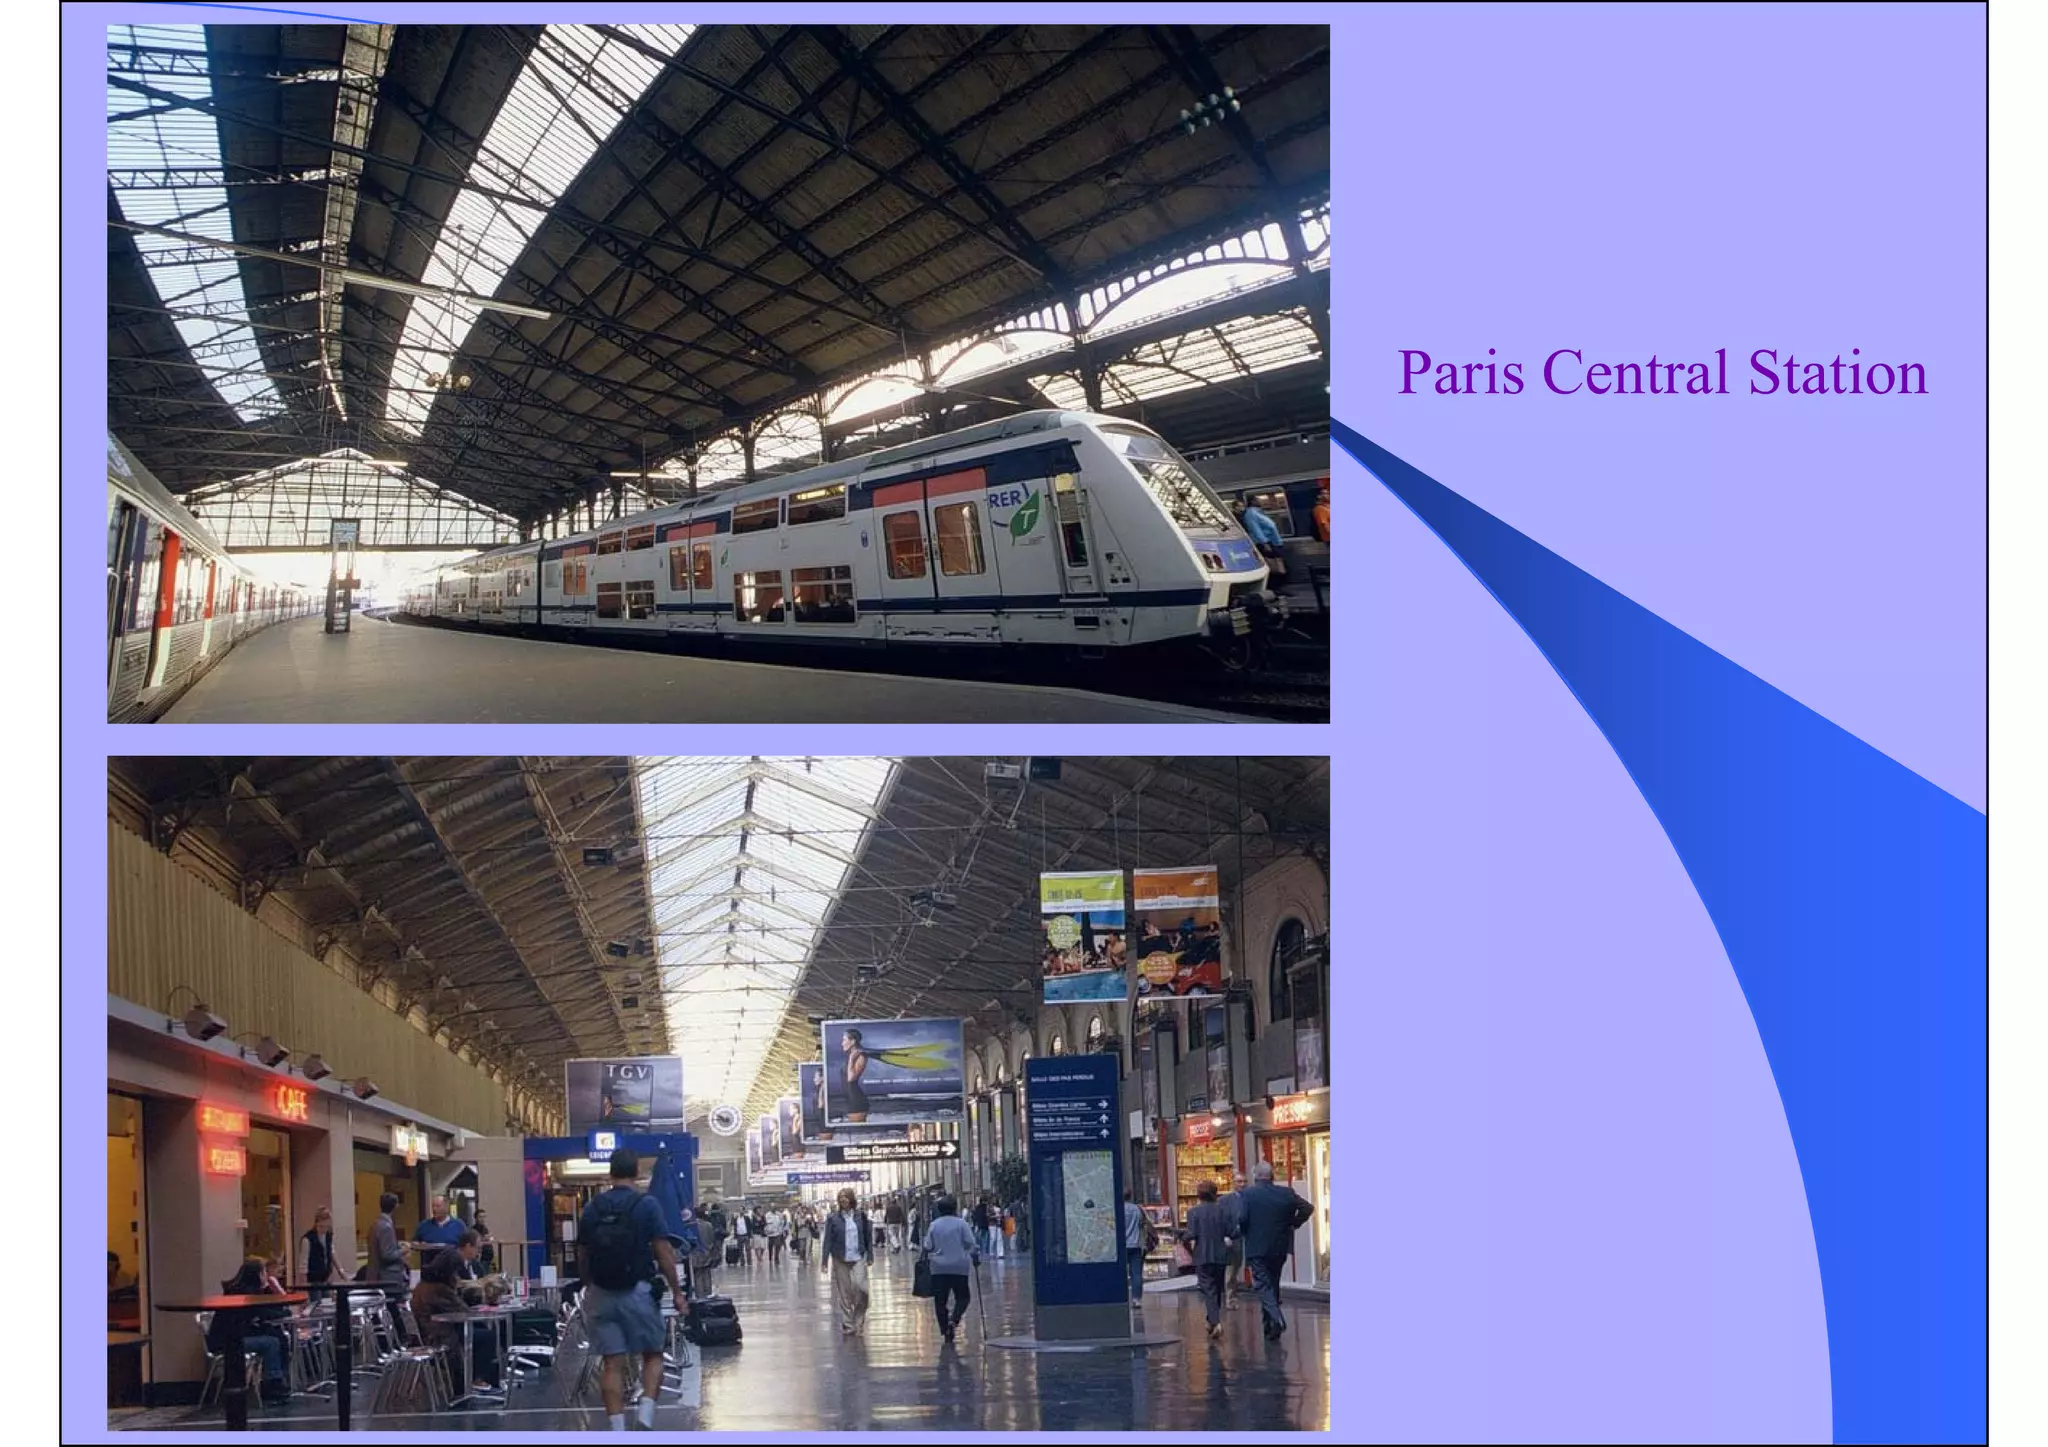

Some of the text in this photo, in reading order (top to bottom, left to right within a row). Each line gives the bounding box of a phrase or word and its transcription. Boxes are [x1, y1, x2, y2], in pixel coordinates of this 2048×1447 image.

[989, 490, 1022, 507] RER
[1020, 508, 1037, 529] T
[606, 1064, 648, 1079] TGV
[872, 1145, 908, 1154] Grandes
[910, 1144, 940, 1153] Lignes
